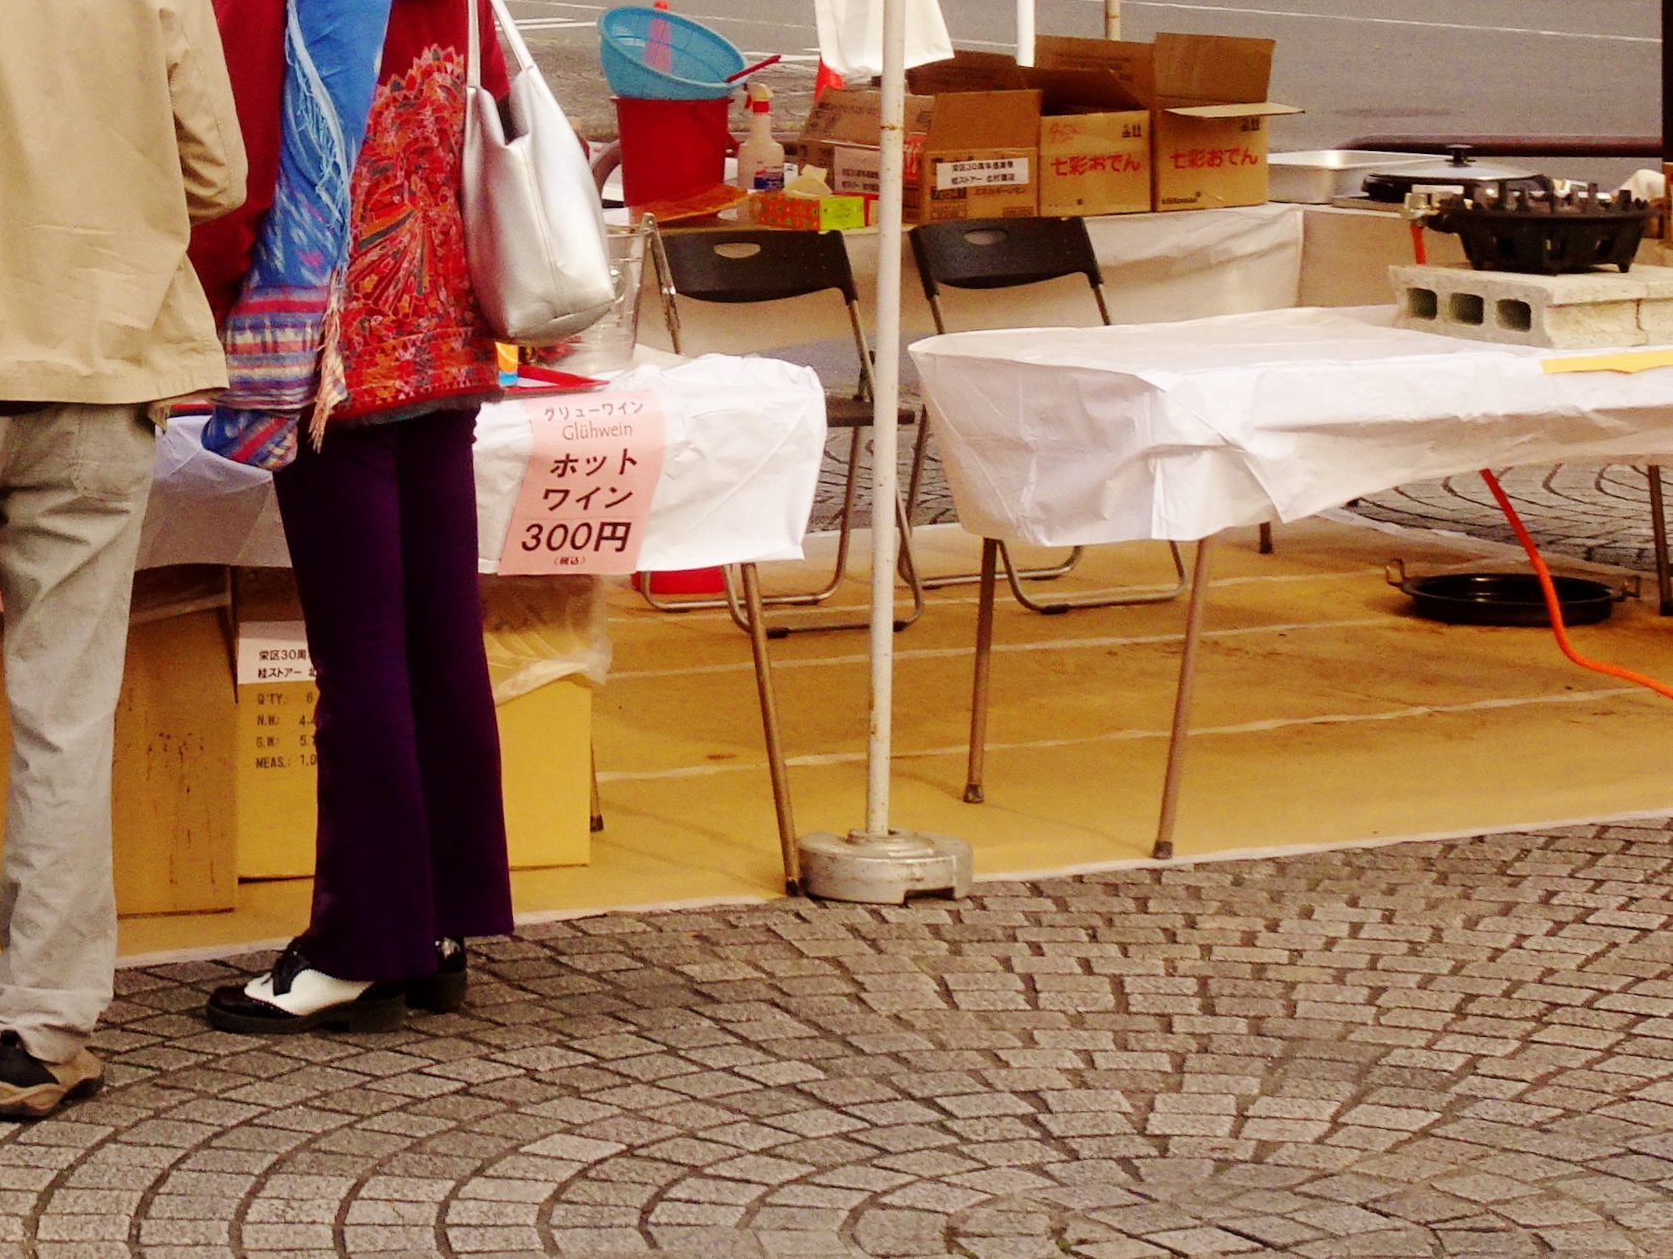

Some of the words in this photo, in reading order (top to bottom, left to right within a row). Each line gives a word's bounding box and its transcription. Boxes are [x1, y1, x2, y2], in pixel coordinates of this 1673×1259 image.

[544, 401, 644, 422] グリューワイン
[561, 420, 634, 441] Glühwein
[550, 448, 639, 478] ホット
[542, 486, 634, 511] ワイン
[521, 521, 633, 553] 300円
